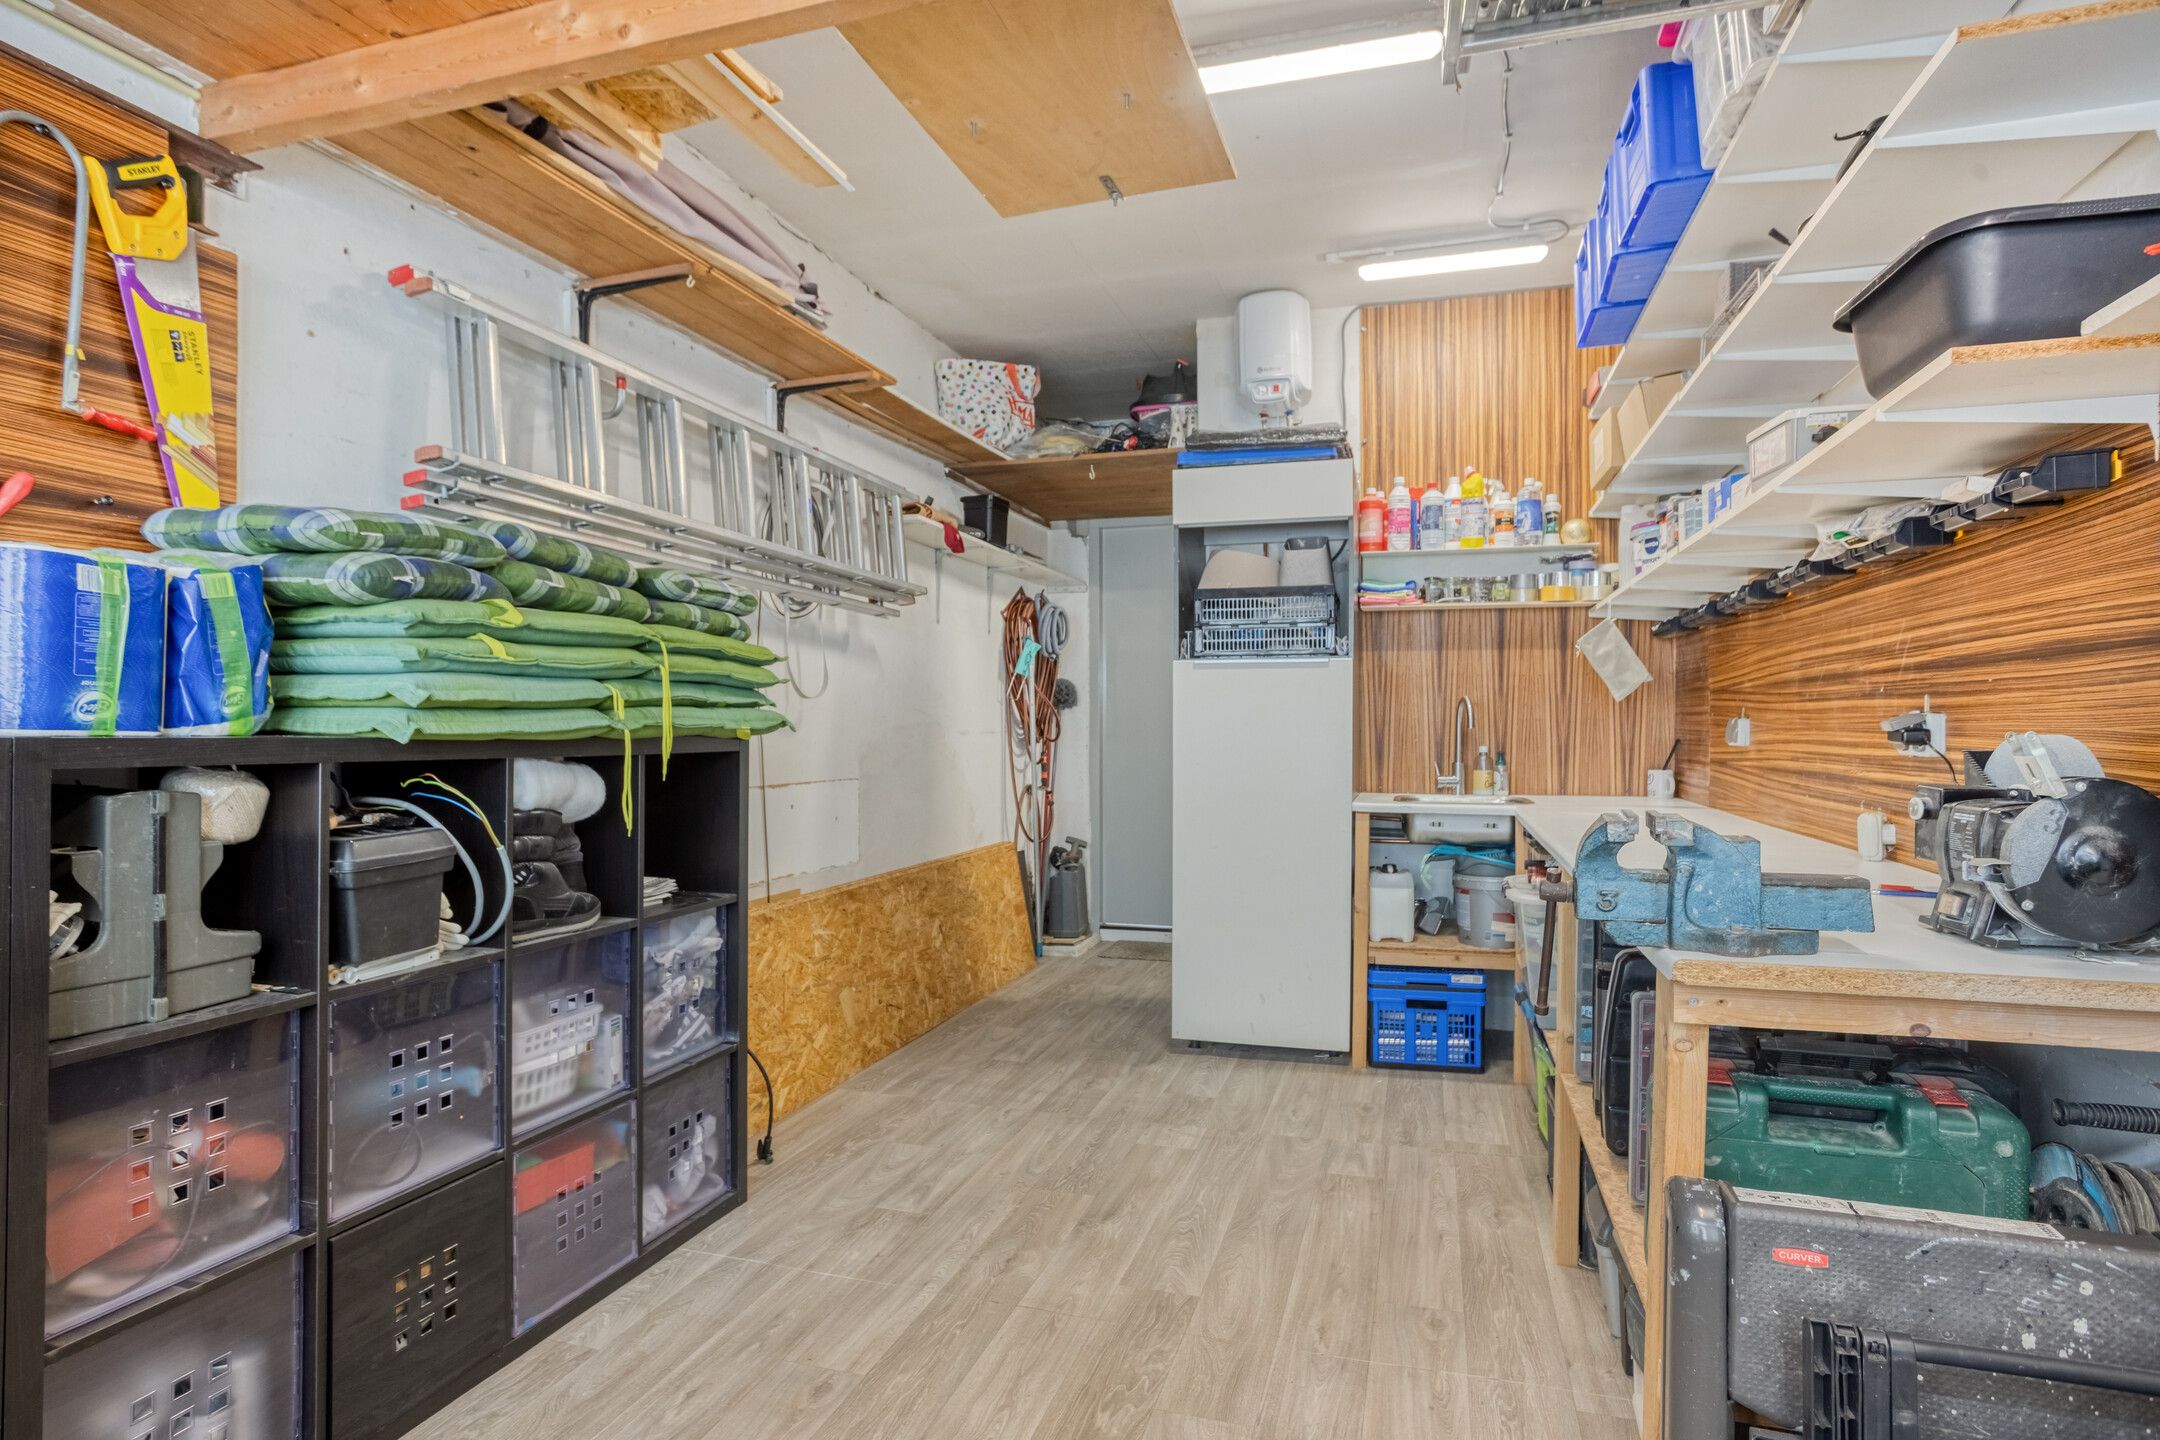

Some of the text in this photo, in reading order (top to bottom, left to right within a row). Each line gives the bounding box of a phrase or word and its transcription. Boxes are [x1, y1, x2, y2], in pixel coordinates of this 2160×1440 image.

[127, 165, 161, 175] STANLEY
[189, 331, 204, 375] STANLEY
[1597, 889, 1618, 912] 3
[1778, 1251, 1821, 1264] CURVER
